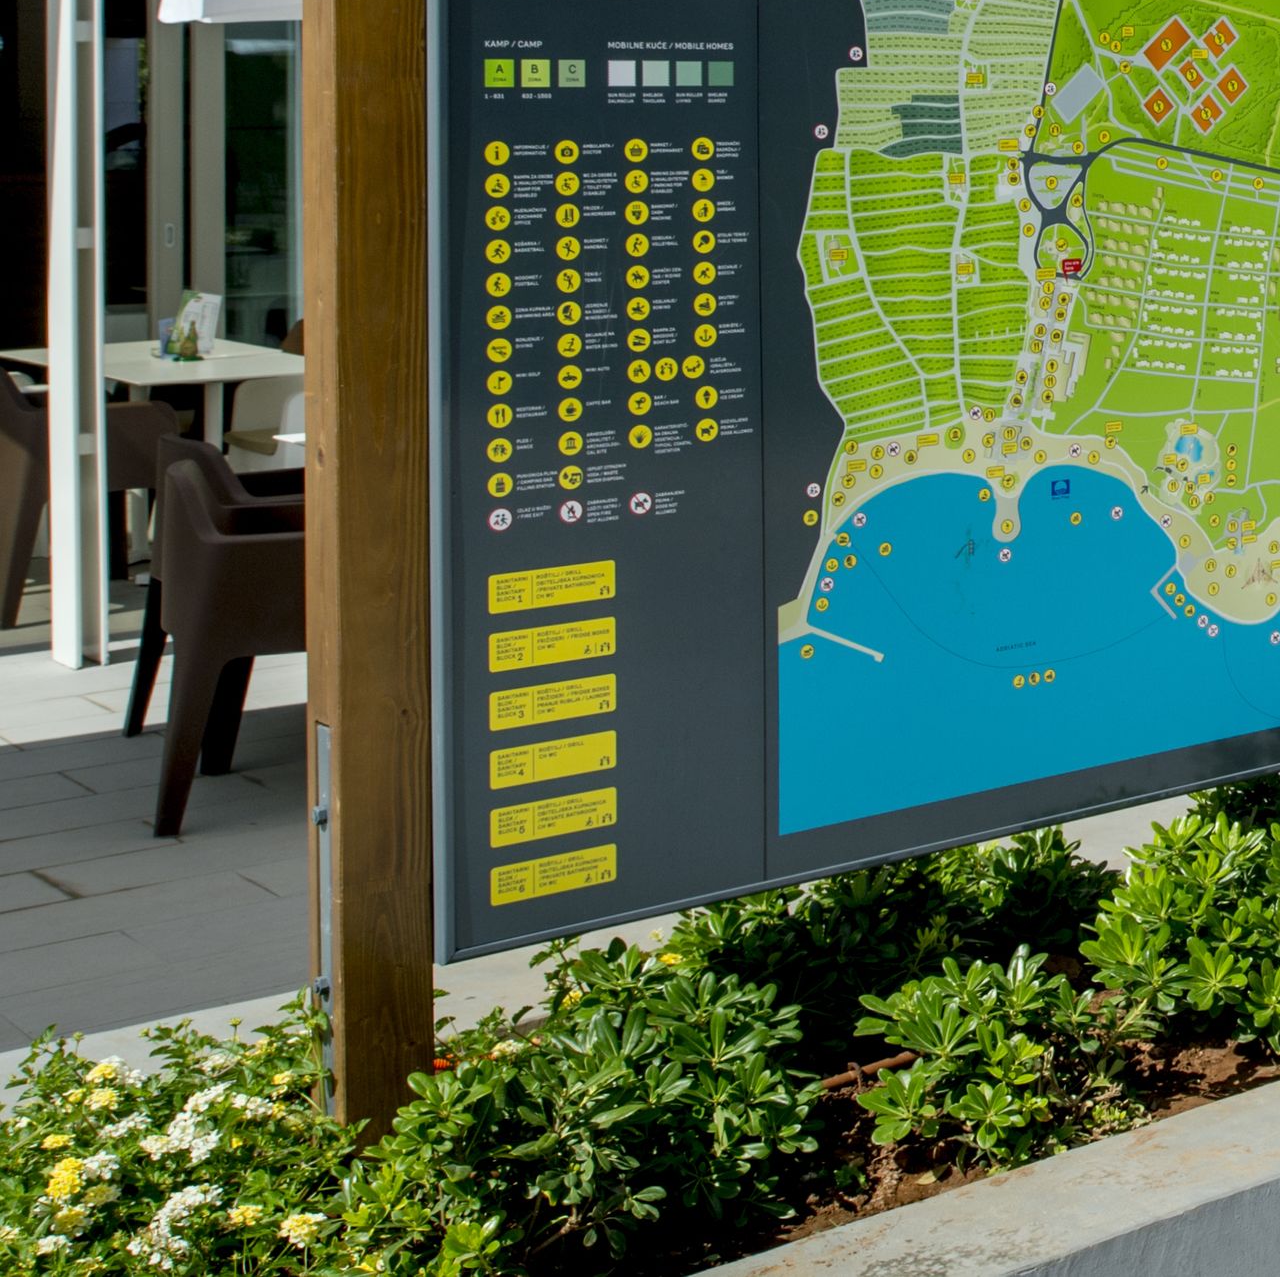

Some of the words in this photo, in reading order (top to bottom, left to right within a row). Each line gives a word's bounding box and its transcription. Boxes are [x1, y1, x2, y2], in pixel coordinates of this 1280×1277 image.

[484, 40, 510, 48] KAMP
[517, 40, 543, 48] CAMP
[607, 41, 644, 49] MOBILNE
[645, 41, 667, 50] KUĆE
[496, 65, 504, 74] A
[531, 65, 539, 74] B
[568, 64, 576, 74] C
[518, 653, 523, 661] 2
[518, 710, 524, 719] 3
[518, 768, 524, 777] 4
[519, 824, 526, 834] 5
[519, 882, 525, 893] 6
